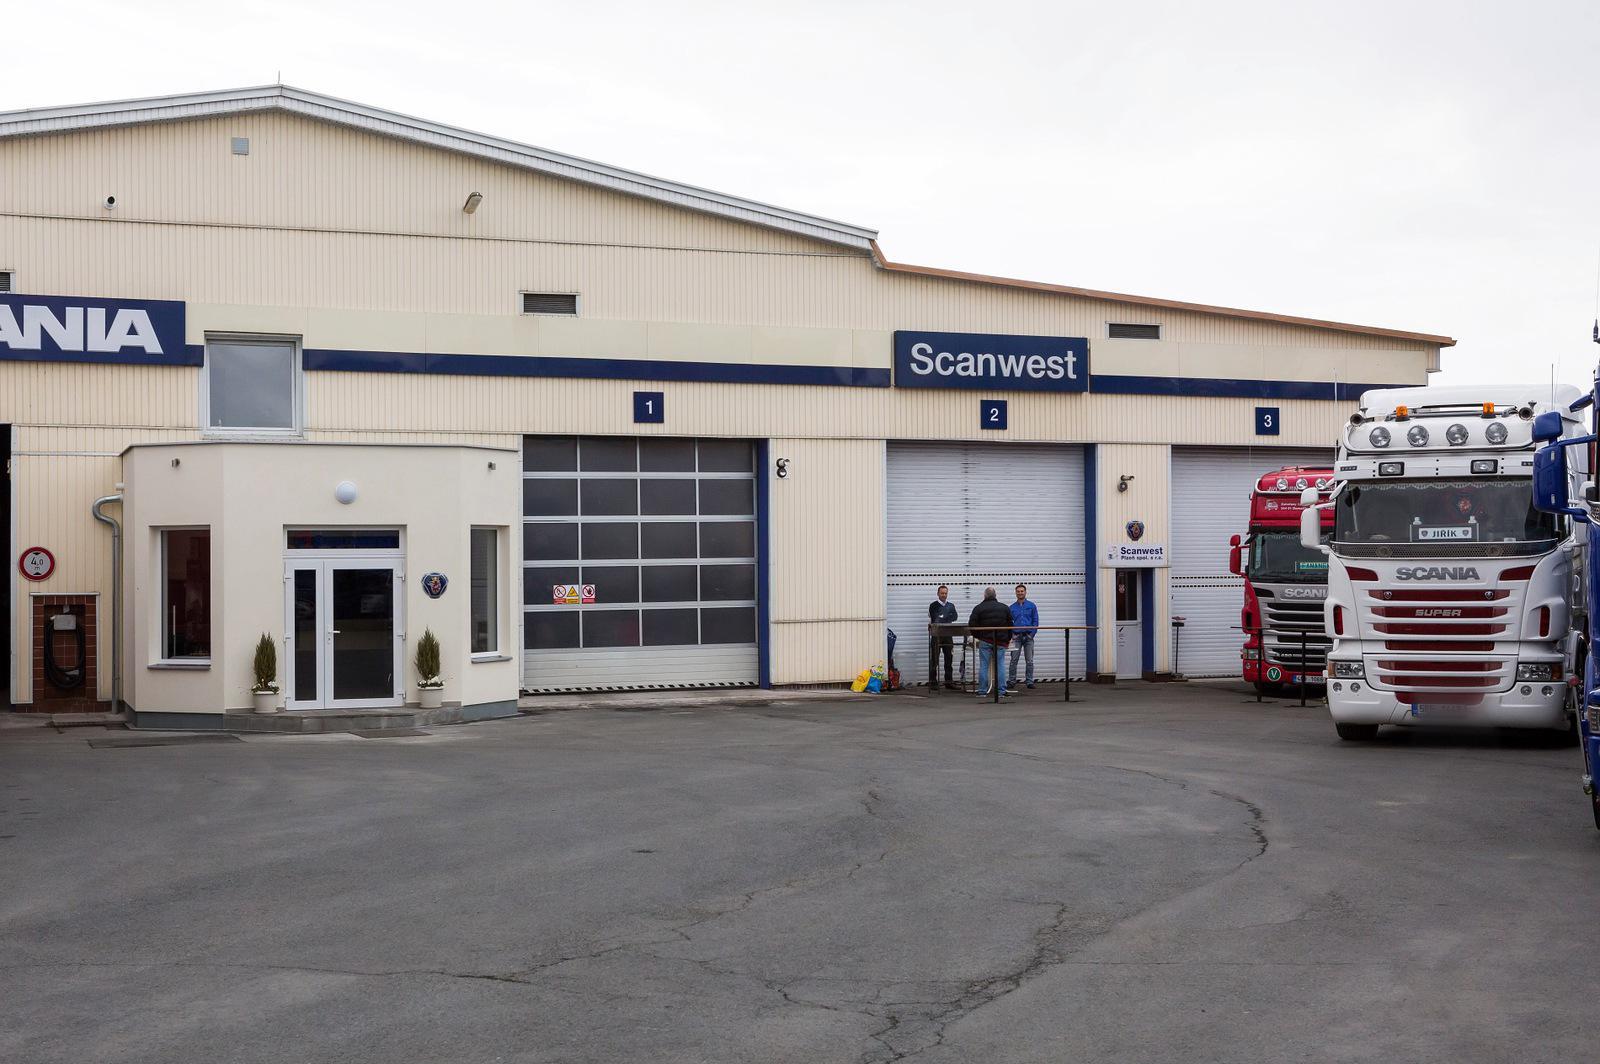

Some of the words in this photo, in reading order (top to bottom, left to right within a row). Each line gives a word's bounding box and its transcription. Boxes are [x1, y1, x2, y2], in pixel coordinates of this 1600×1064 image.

[910, 342, 1077, 380] Scanwest
[645, 400, 653, 415] 1
[990, 408, 999, 421] 2
[1264, 414, 1272, 428] 3
[1120, 546, 1163, 555] Scanwest
[1395, 566, 1480, 581] SCANIA
[1415, 609, 1461, 617] SUPER
[1270, 669, 1278, 681] V
